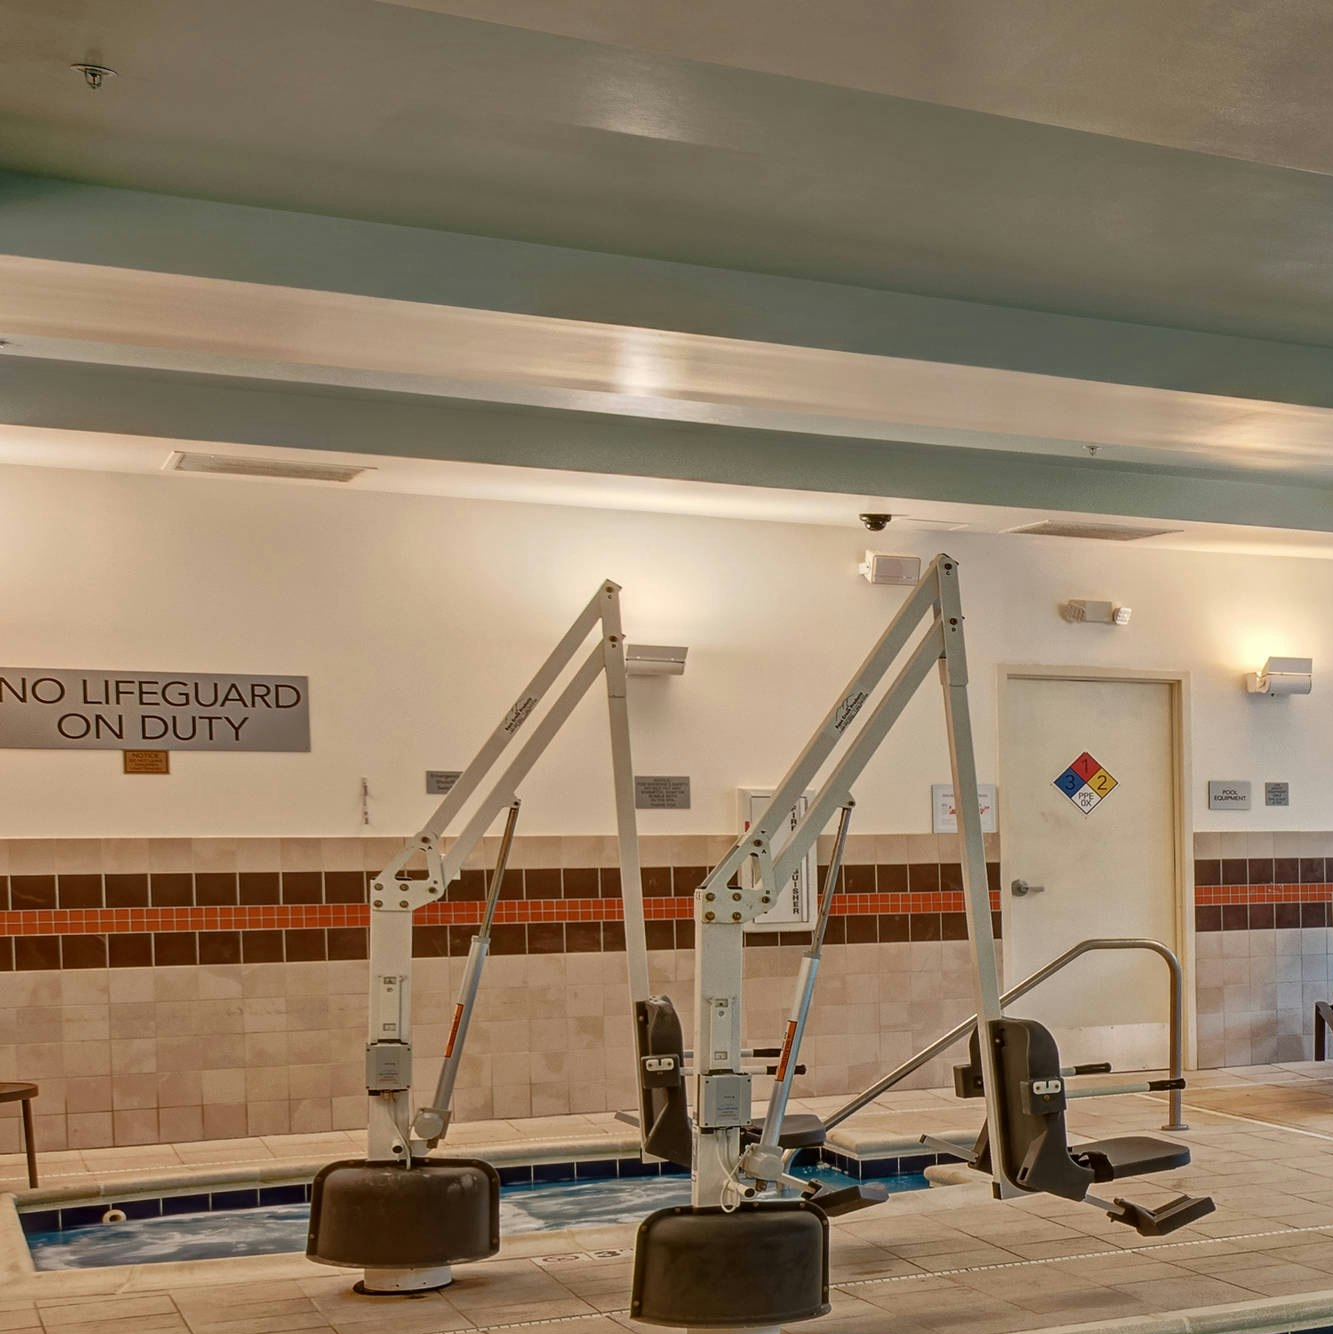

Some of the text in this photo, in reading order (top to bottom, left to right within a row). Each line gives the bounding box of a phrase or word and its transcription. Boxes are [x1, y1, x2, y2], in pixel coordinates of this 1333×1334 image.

[0, 677, 302, 709] NO LIFEGUARD
[57, 713, 249, 741] ON DUTY
[1081, 759, 1089, 774] 1
[1065, 774, 1075, 790] 3
[1097, 774, 1107, 790] 2
[1079, 792, 1094, 800] PPE
